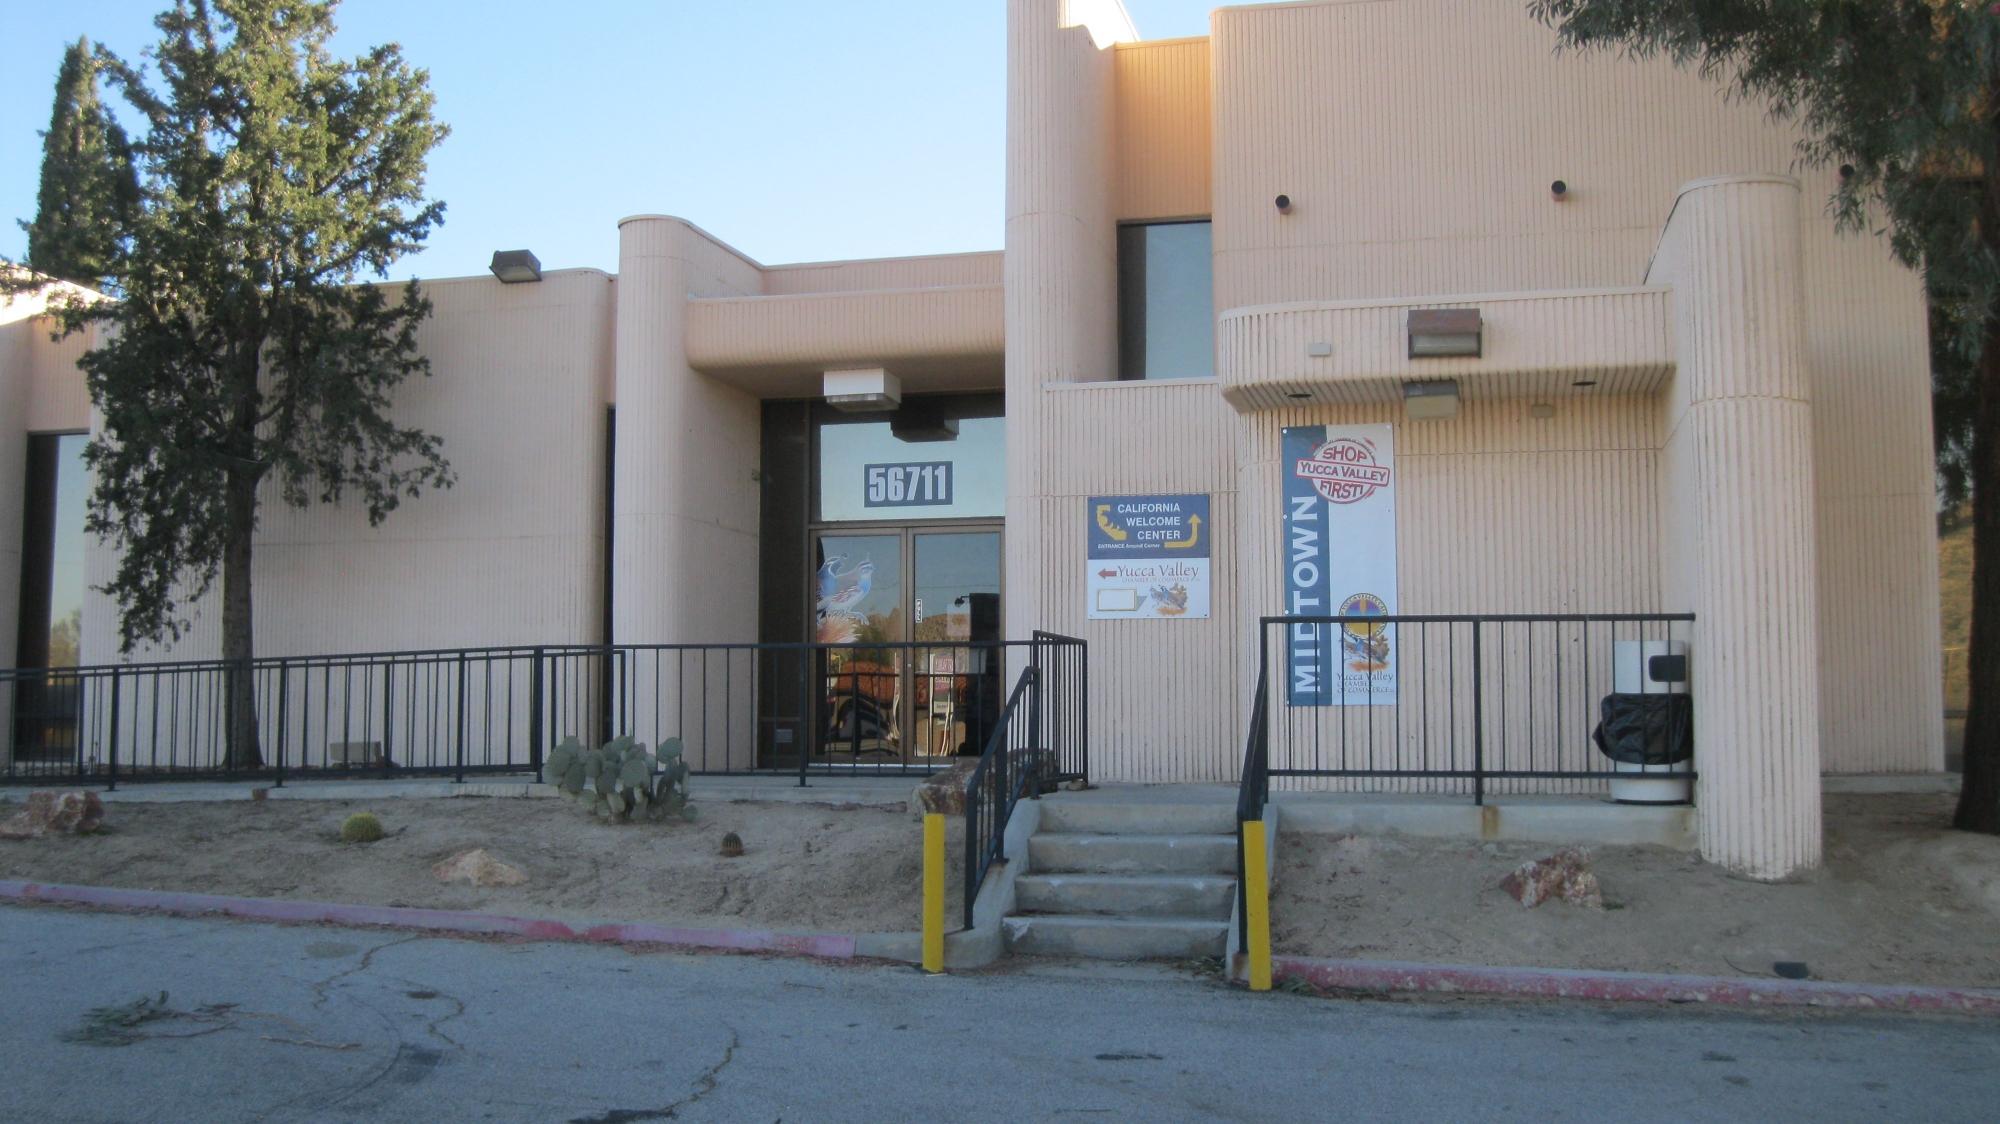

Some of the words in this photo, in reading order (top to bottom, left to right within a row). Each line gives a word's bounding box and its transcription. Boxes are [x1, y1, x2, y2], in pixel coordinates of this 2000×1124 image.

[1323, 445, 1367, 462] SHOP
[1300, 461, 1339, 477] YUCCA
[1341, 466, 1387, 482] VALLEY
[869, 465, 947, 502] 56711
[1117, 503, 1181, 513] CALIFORNIA
[1126, 516, 1181, 526] WELCOME
[1137, 530, 1181, 540] CENTER
[1118, 564, 1155, 577] Yucca
[1159, 561, 1199, 579] Valley
[1292, 495, 1320, 692] MIDTOWN
